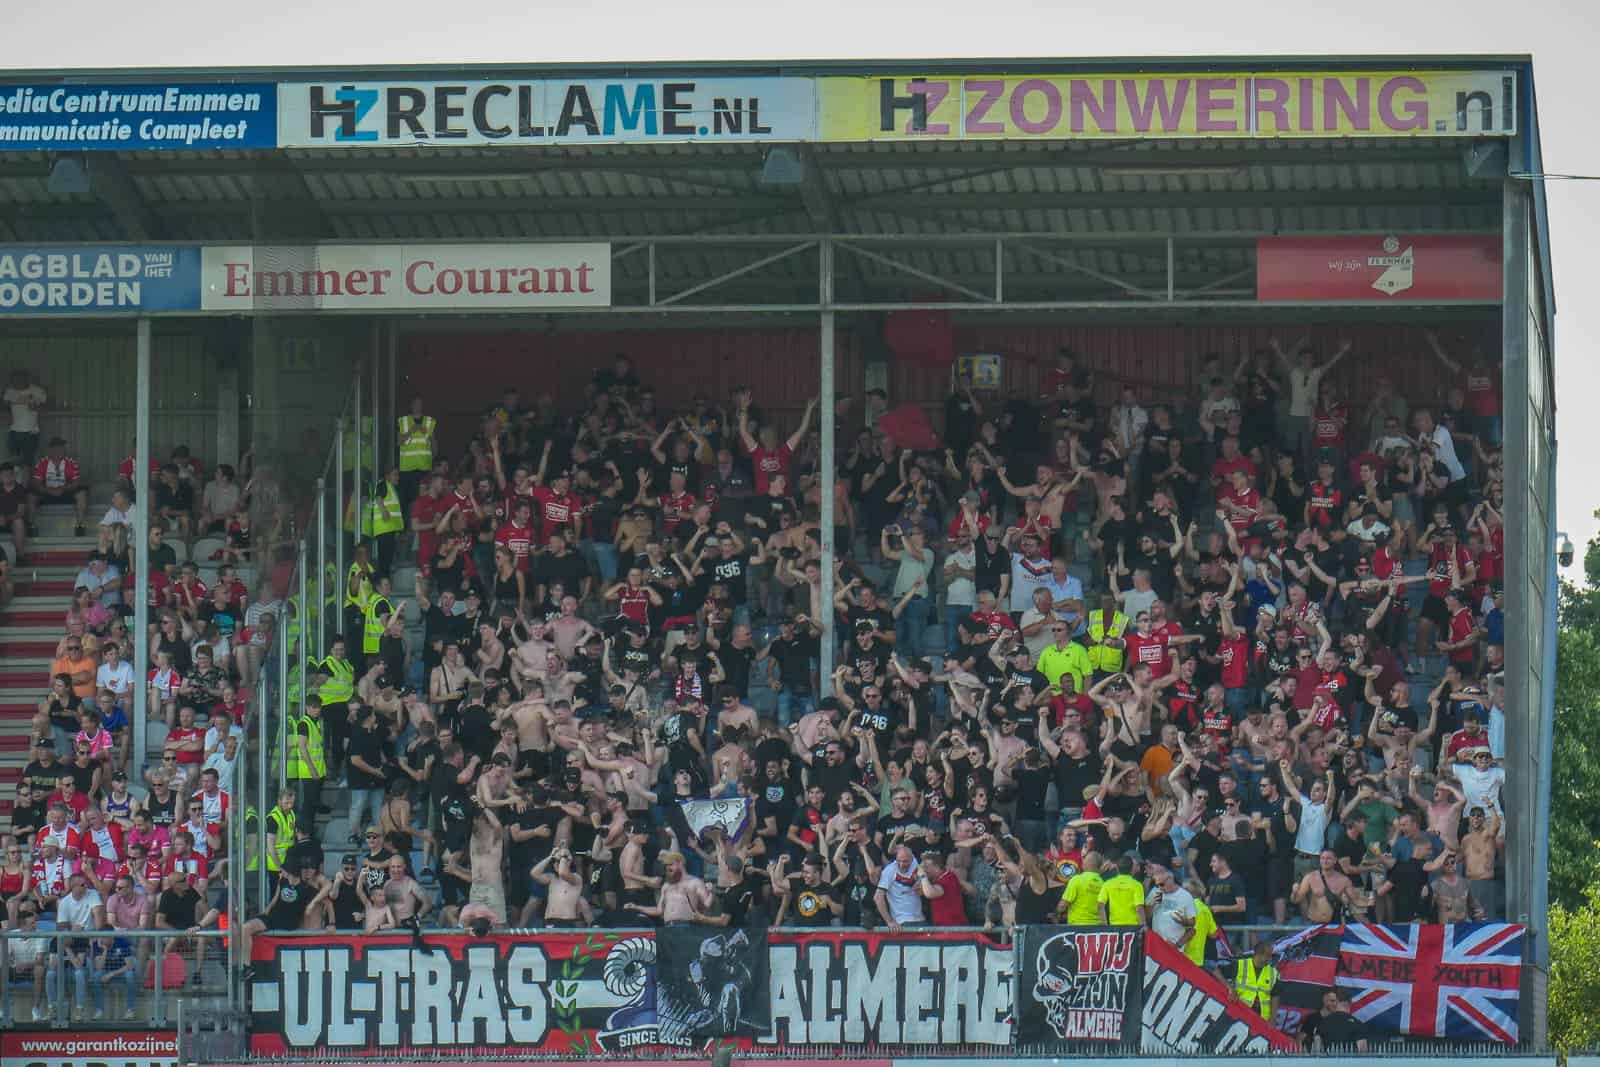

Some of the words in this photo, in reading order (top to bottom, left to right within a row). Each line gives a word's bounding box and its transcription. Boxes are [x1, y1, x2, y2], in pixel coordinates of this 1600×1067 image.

[139, 117, 247, 144] Compleet
[144, 253, 172, 266] VAN
[145, 266, 172, 278] HET
[223, 263, 391, 297] Emmer
[405, 260, 594, 295] Courant
[1075, 932, 1135, 974] WIJ
[1336, 955, 1417, 983] ALMERE
[1432, 964, 1502, 986] YOUTH
[280, 947, 548, 1047] ULTRAS
[757, 944, 1014, 1045] ALMERE
[1070, 972, 1128, 1011] ZIJN
[618, 1030, 657, 1048] SINCE
[1065, 1009, 1122, 1040] ALMERE
